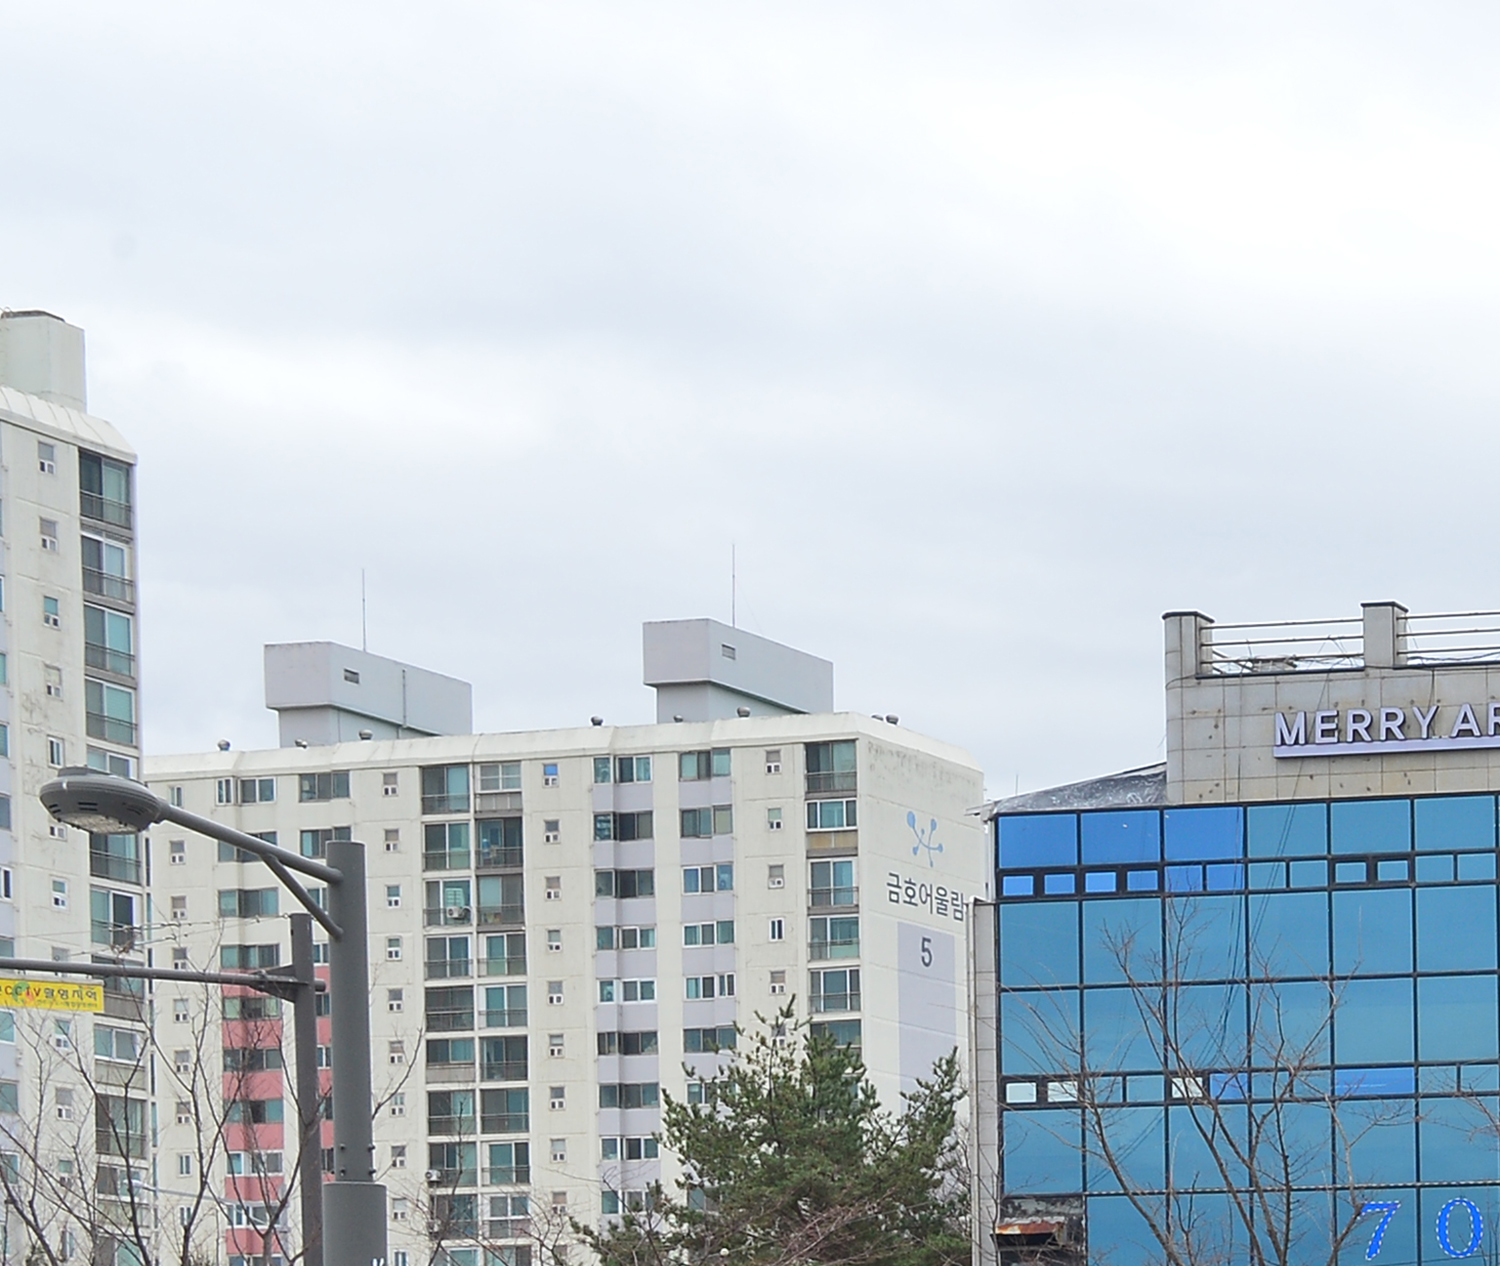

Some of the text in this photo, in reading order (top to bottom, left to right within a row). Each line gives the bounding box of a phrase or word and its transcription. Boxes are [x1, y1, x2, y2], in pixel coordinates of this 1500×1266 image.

[1274, 705, 1440, 746] MERRY
[887, 872, 964, 922] 금호어울림
[921, 937, 933, 968] 5
